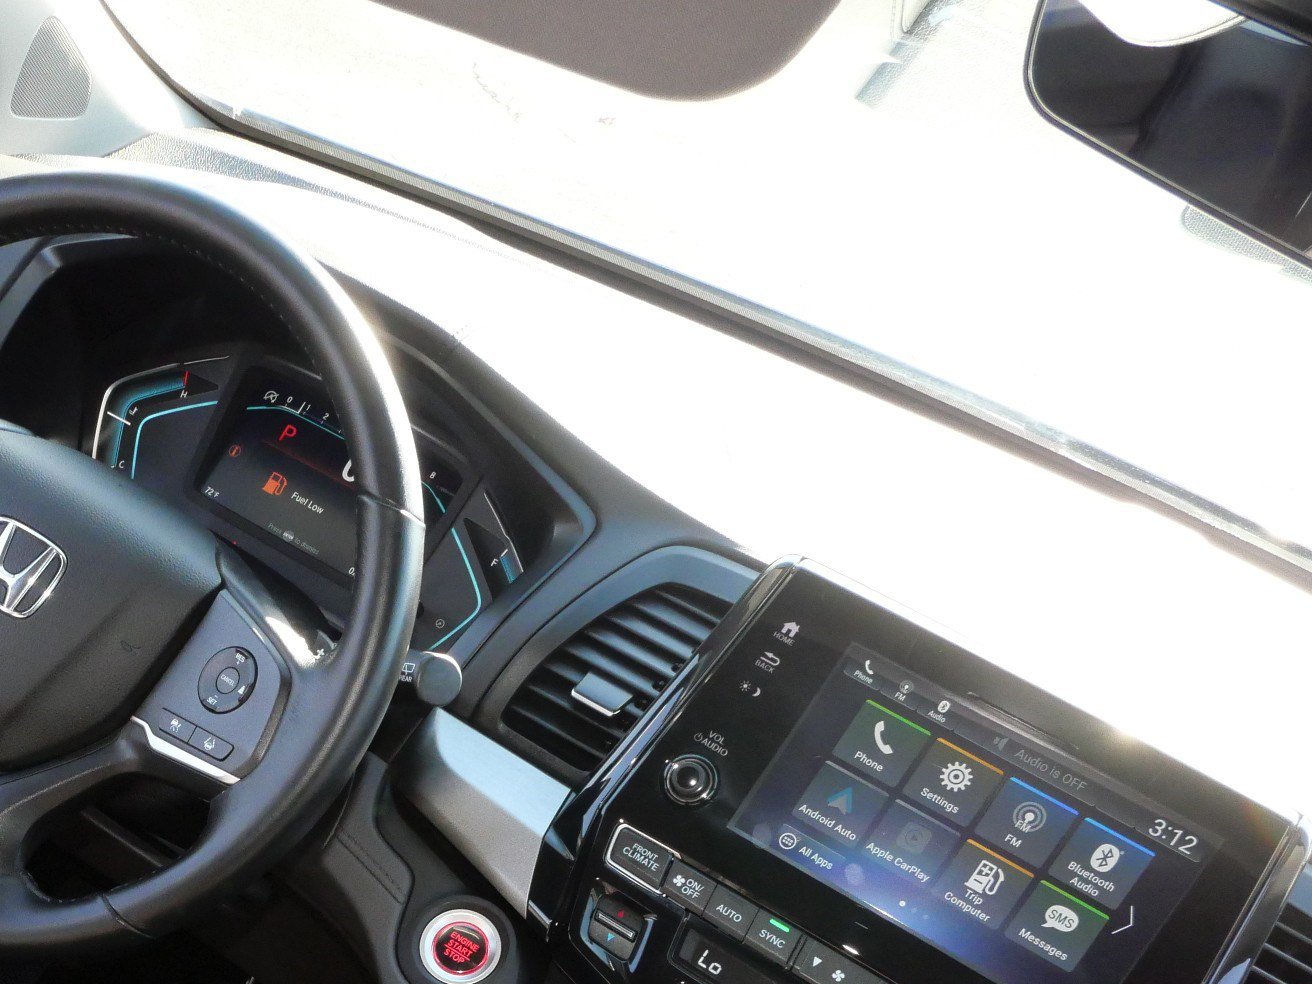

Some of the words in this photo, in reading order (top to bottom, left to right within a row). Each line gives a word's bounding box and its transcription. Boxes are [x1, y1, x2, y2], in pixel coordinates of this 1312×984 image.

[179, 389, 188, 398] H
[322, 412, 330, 421] 2
[278, 424, 298, 442] P
[290, 491, 309, 507] Fuel
[307, 499, 325, 516] Low
[773, 631, 796, 647] HOME
[754, 659, 775, 674] BACK
[220, 674, 235, 687] CANCEL
[854, 669, 874, 685] Phone
[206, 696, 218, 706] SET
[894, 691, 906, 702] FM
[927, 710, 946, 723] Audio
[701, 738, 729, 757] AUDIO
[708, 730, 725, 746] VOL
[854, 750, 884, 773] Phone
[1014, 749, 1048, 773] Audio
[1049, 767, 1060, 779] is
[1062, 773, 1088, 792] OFF
[920, 787, 959, 815] Settings
[798, 803, 834, 829] Android
[833, 823, 857, 842] Auto
[1004, 833, 1023, 849] FM
[1148, 819, 1198, 855] 3:12
[622, 846, 660, 873] CLIMATE
[631, 842, 659, 861] FRONT
[798, 845, 812, 859] All
[811, 852, 834, 872] Apps
[866, 841, 894, 864] Apple
[894, 857, 931, 885] CarPlay
[685, 878, 706, 893] ON/
[1067, 861, 1115, 893] Bluetooth
[1069, 875, 1099, 897] Audio
[681, 885, 701, 900] OFF
[964, 888, 983, 906] Trip
[715, 904, 742, 923] AUTO
[944, 891, 991, 923] Computer
[1047, 908, 1075, 929] SMS
[447, 939, 474, 957] START
[449, 931, 480, 953] ENGINE
[759, 929, 786, 949] SYNC
[1018, 928, 1068, 962] Messages
[443, 948, 465, 963] STOP
[697, 949, 722, 975] Lo
